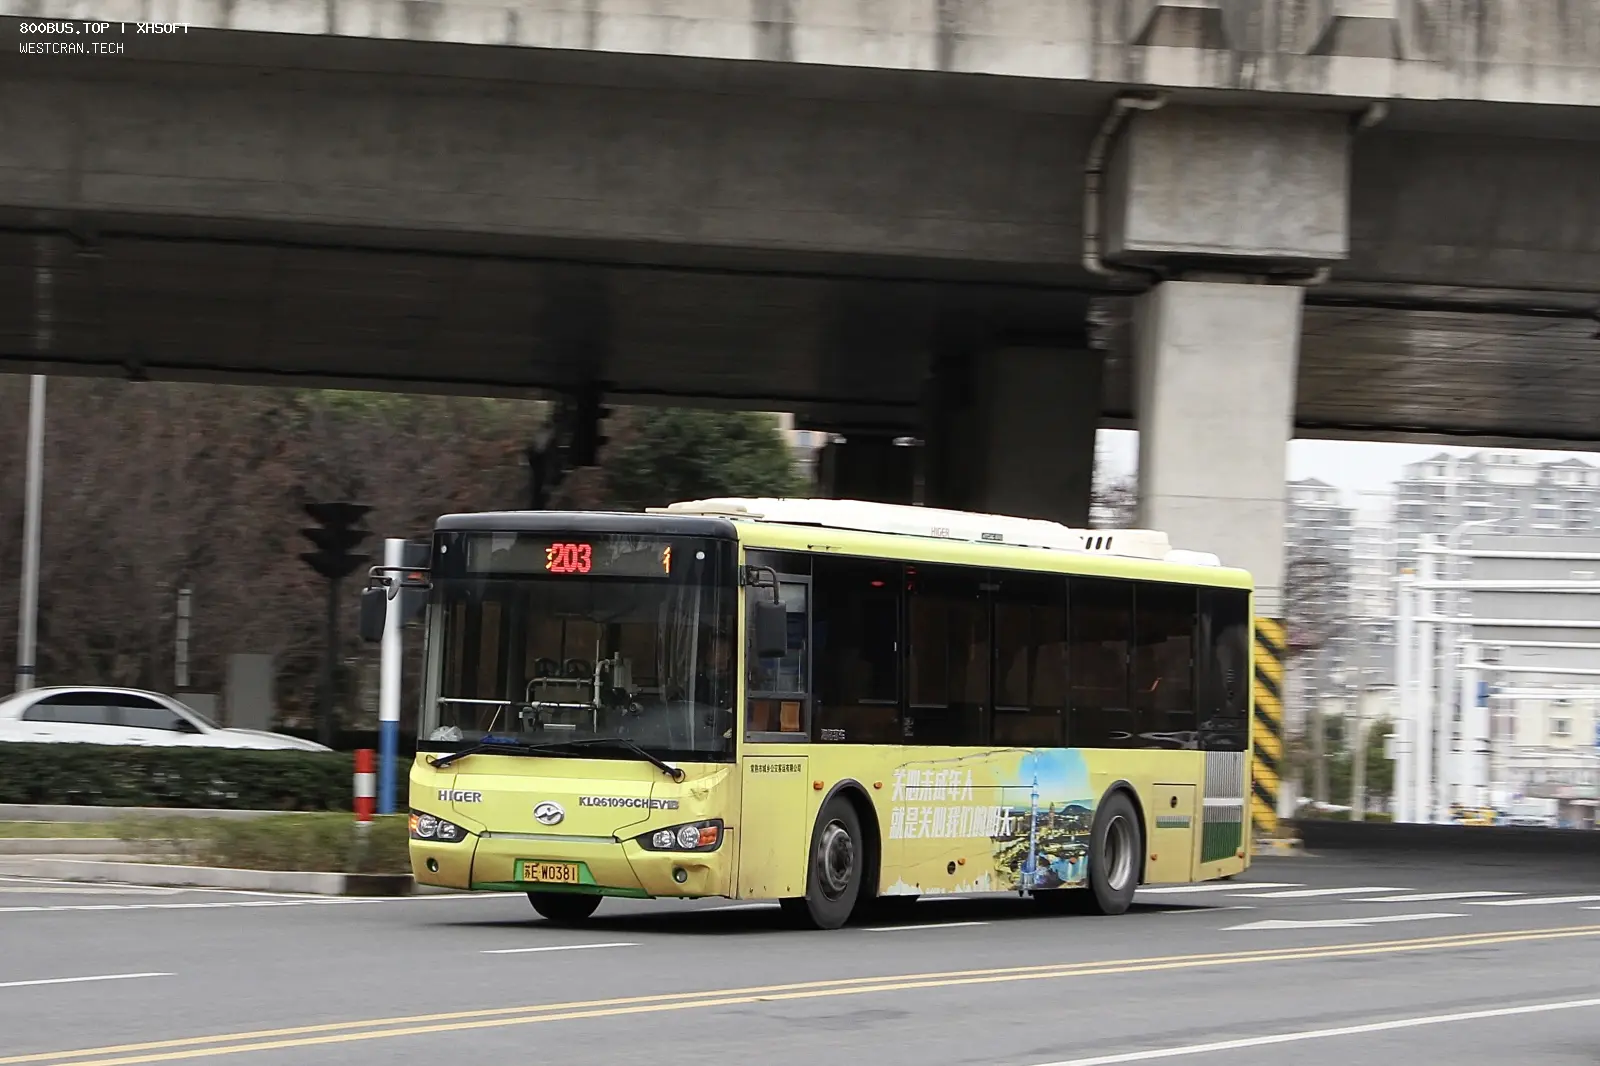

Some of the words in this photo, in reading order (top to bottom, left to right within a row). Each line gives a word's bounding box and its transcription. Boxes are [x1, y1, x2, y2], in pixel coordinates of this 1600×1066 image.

[931, 527, 949, 537] HIGER
[551, 543, 592, 573] 203
[437, 790, 482, 803] HIGER
[891, 768, 973, 802] 关心未成年人
[889, 806, 1014, 839] 就是关心我们的明天
